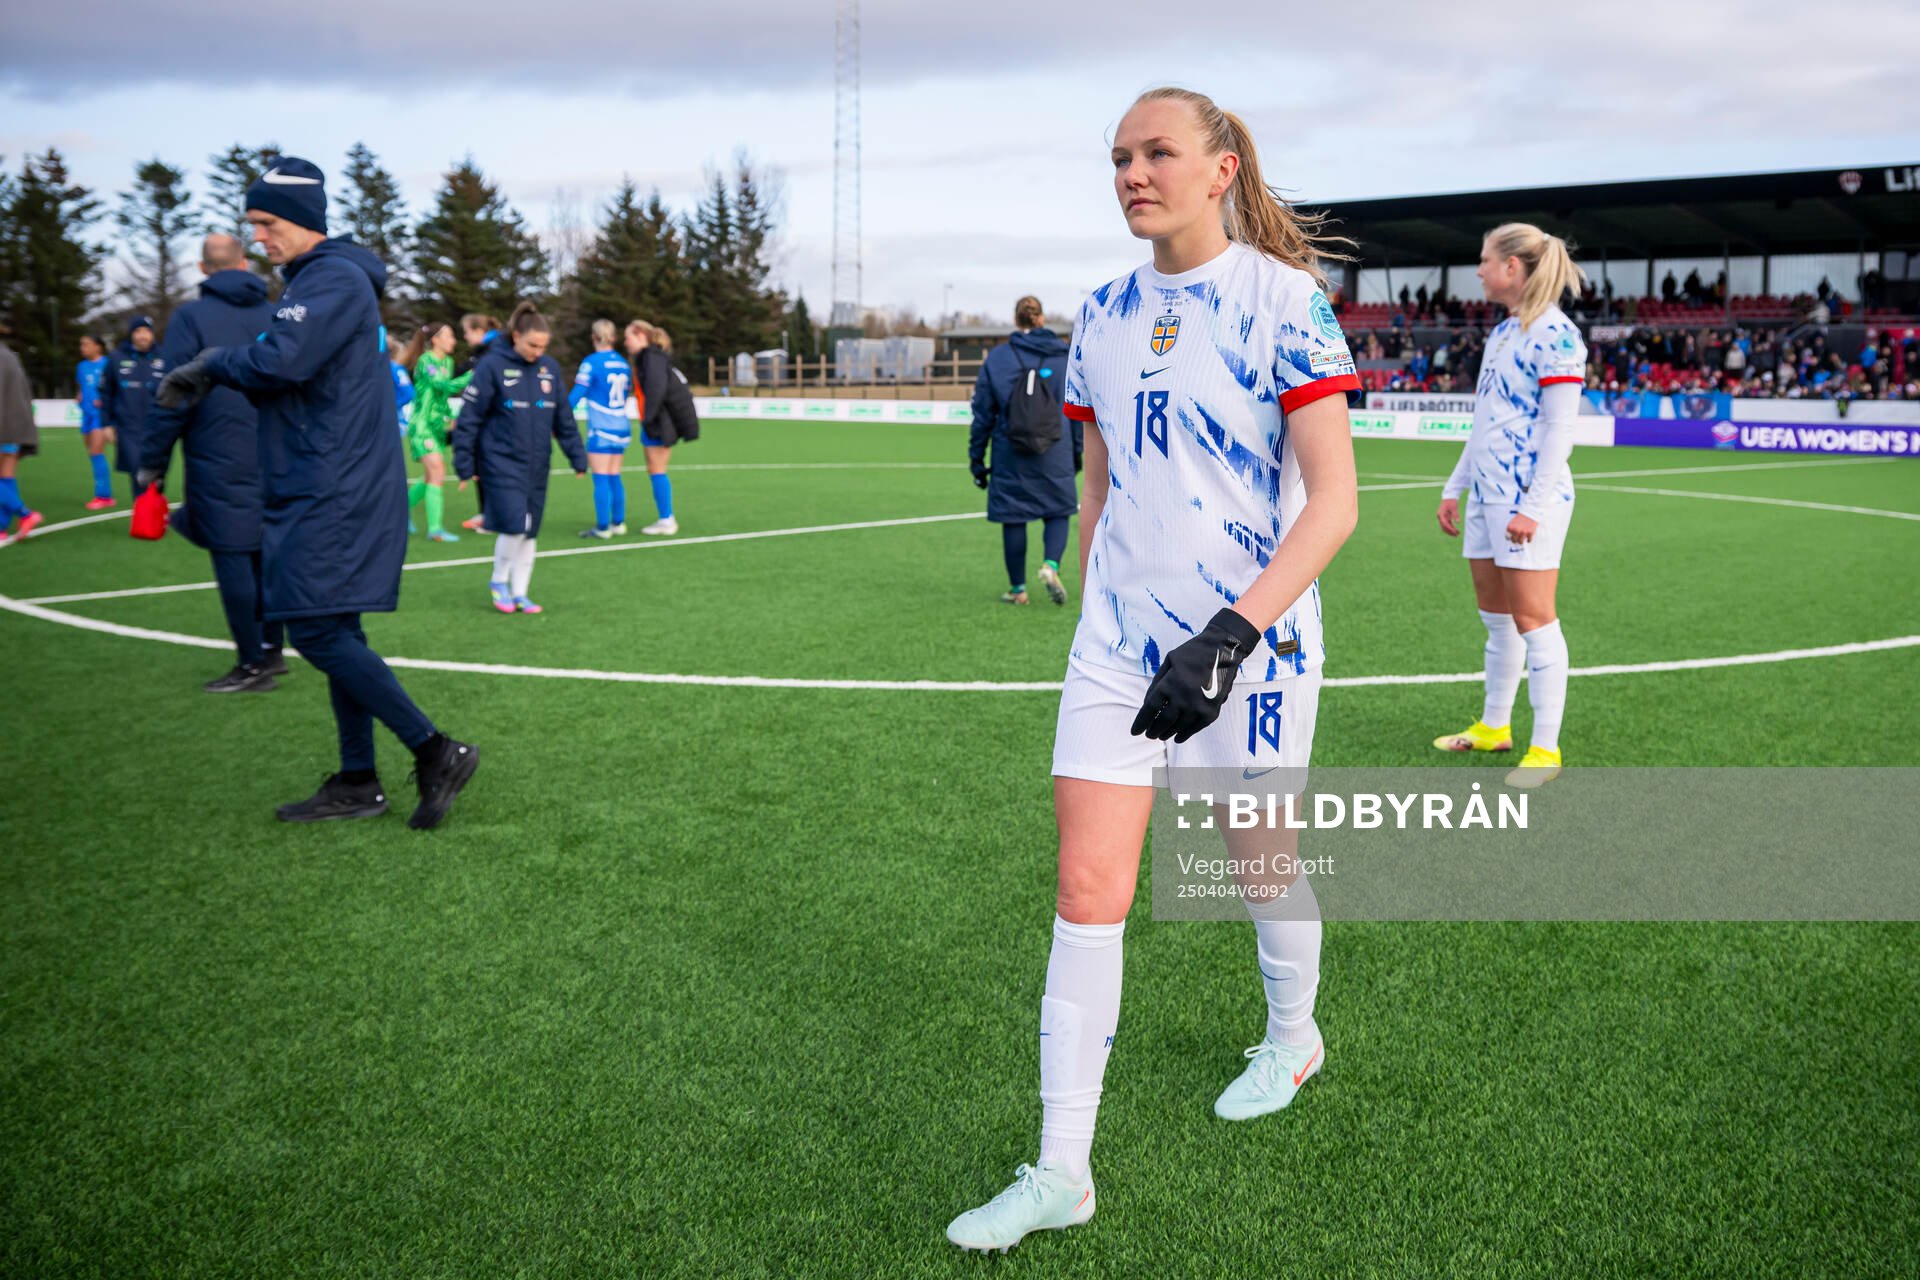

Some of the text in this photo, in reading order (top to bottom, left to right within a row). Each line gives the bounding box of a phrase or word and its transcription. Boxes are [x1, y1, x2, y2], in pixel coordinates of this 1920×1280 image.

[1133, 390, 1170, 460] 18
[1740, 426, 1798, 450] UEFA
[1797, 428, 1909, 453] WOMEN'S
[1245, 691, 1283, 757] 18
